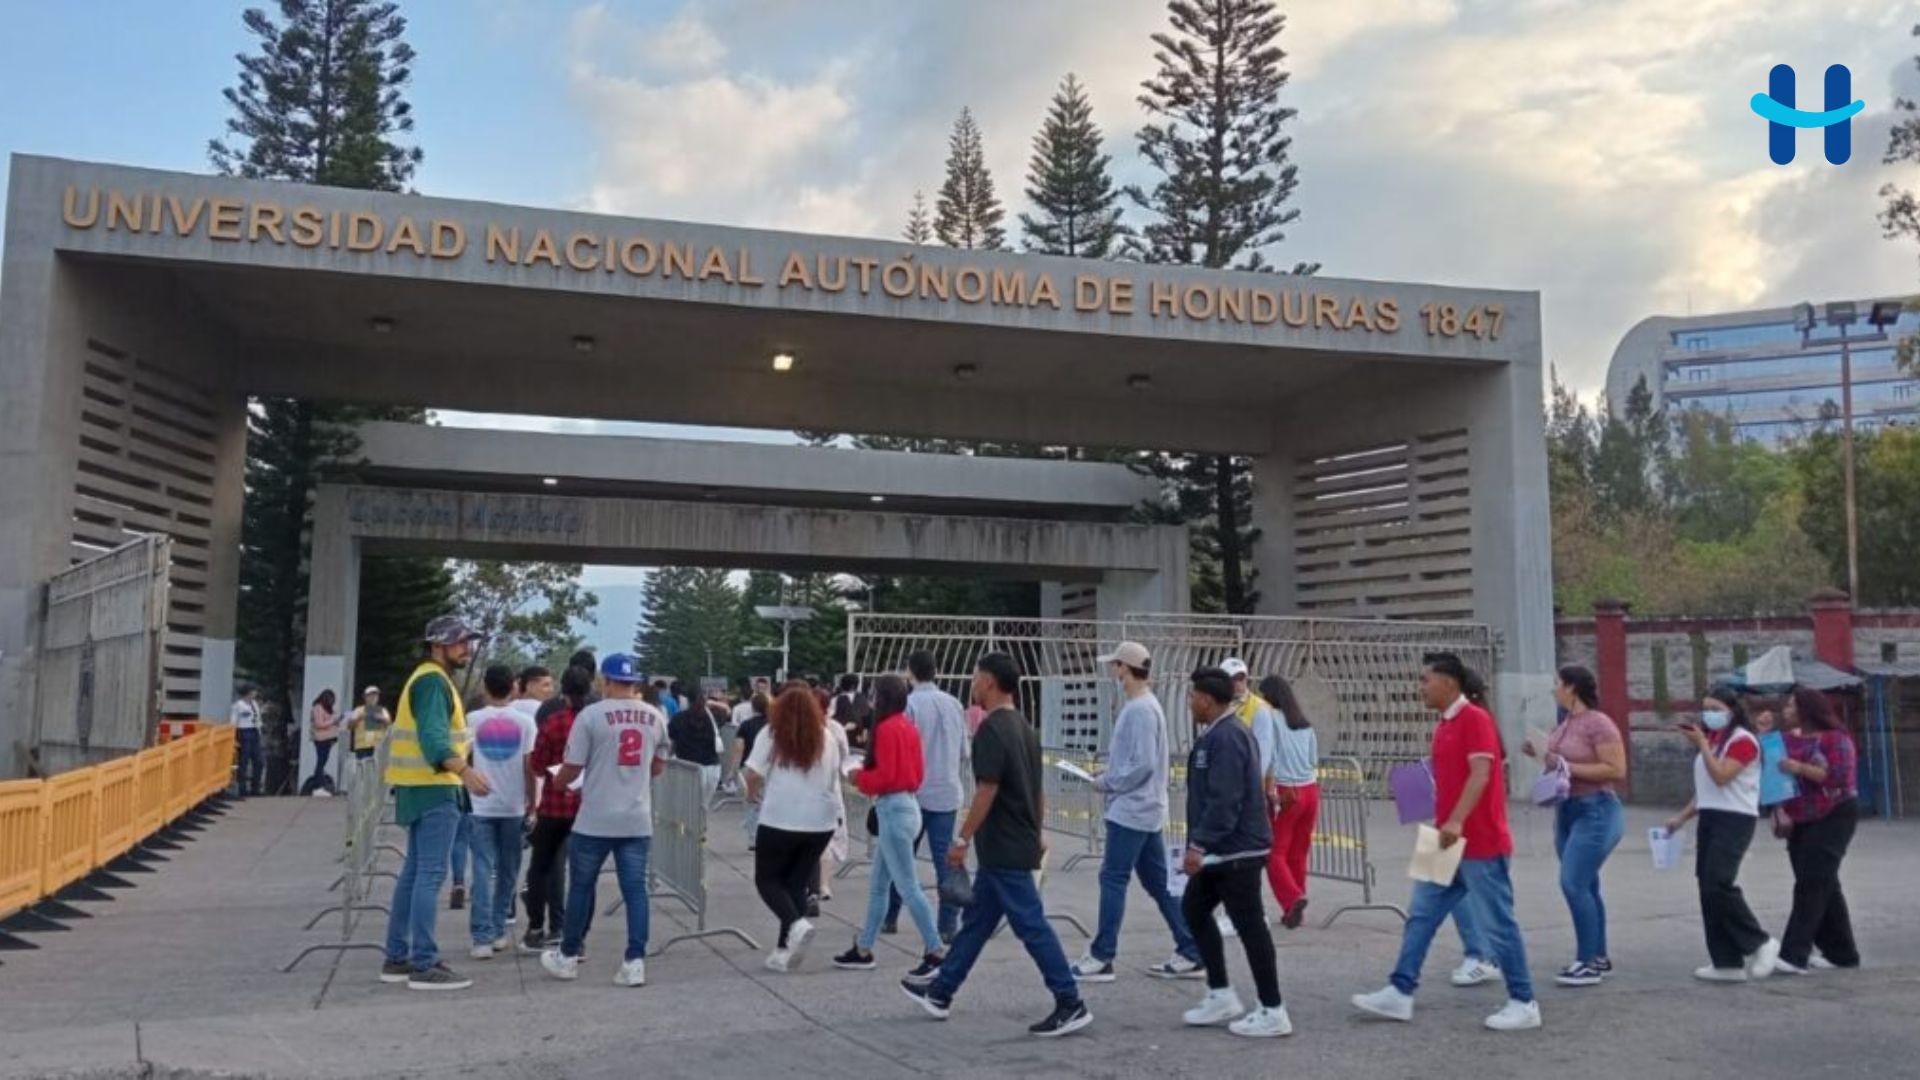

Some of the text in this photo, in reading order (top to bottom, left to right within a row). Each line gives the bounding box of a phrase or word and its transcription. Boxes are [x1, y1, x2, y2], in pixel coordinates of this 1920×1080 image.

[63, 186, 1504, 340] UNIVERSIDAD NACIONAL AUTÓNOMA DE HONDURAS 1847
[617, 729, 642, 766] 2
